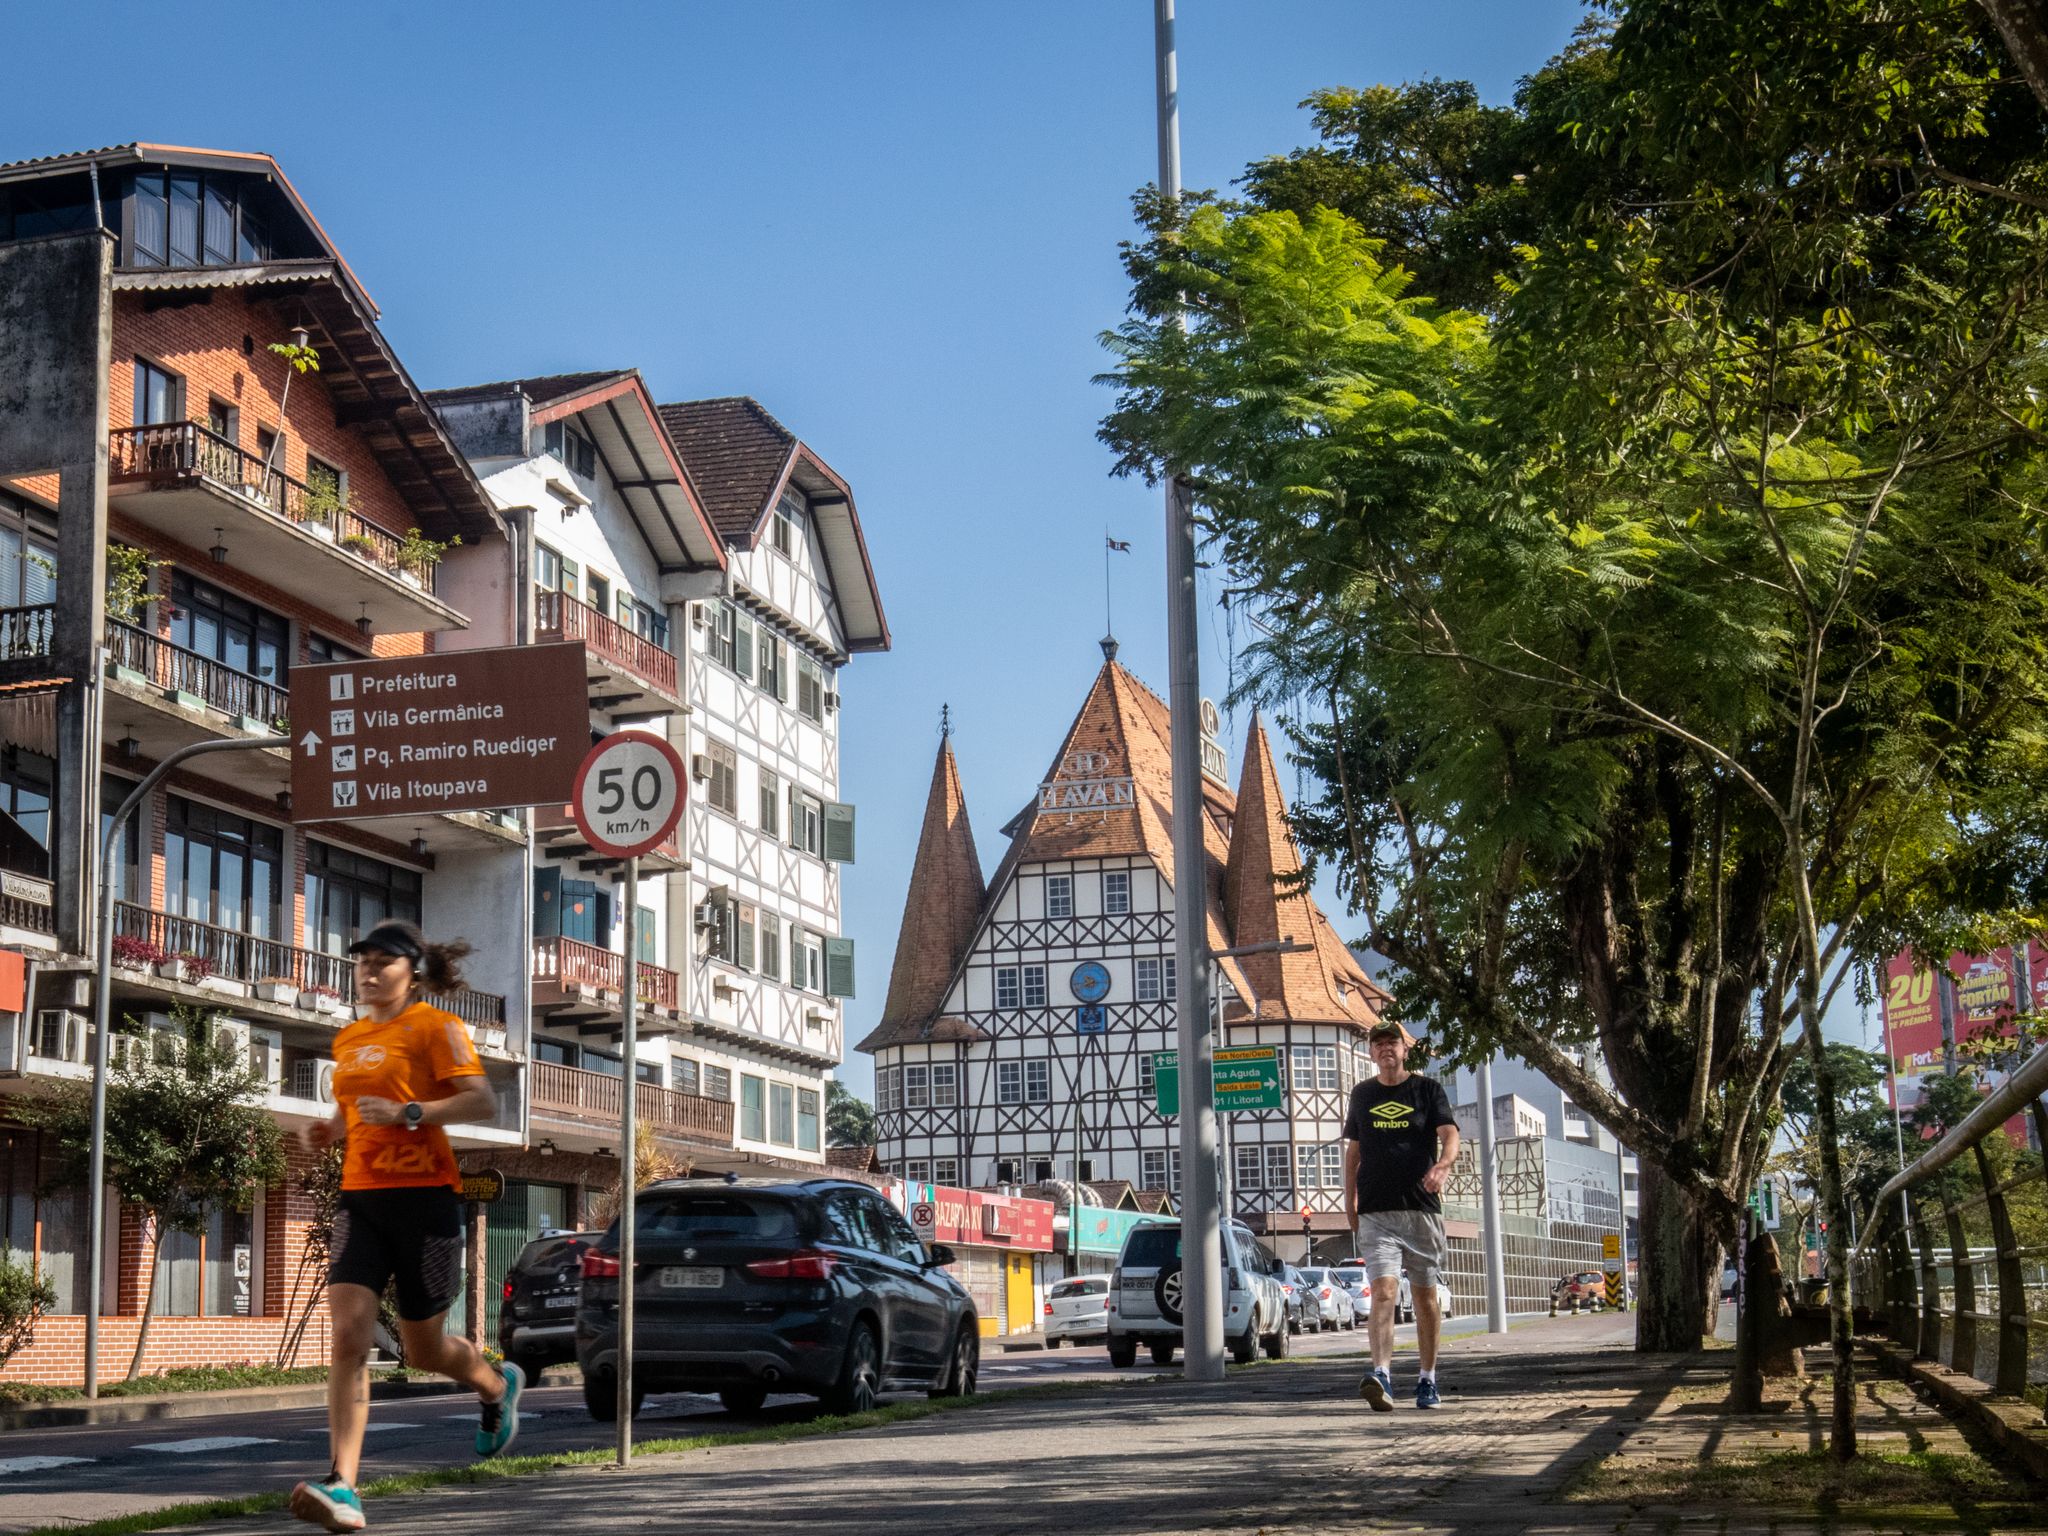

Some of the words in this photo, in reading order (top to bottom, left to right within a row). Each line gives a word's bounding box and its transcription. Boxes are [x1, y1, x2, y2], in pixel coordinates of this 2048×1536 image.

[362, 671, 457, 694] Prefeitura
[363, 710, 399, 728] Vila
[405, 702, 504, 726] Germânica
[364, 747, 394, 769] Pq.
[400, 741, 468, 763] Ramiro
[473, 736, 557, 761] Ruediger
[366, 782, 402, 801] Vila
[408, 777, 488, 801] Itoupava
[597, 764, 662, 815] 50
[1038, 782, 1133, 808] HAVAN
[606, 817, 650, 835] km/h
[1889, 968, 1933, 1009] 20
[1912, 1050, 1932, 1067] Fort
[1230, 1068, 1261, 1080] Aguda
[1233, 1095, 1264, 1105] Litoral
[1373, 1120, 1409, 1129] umbro
